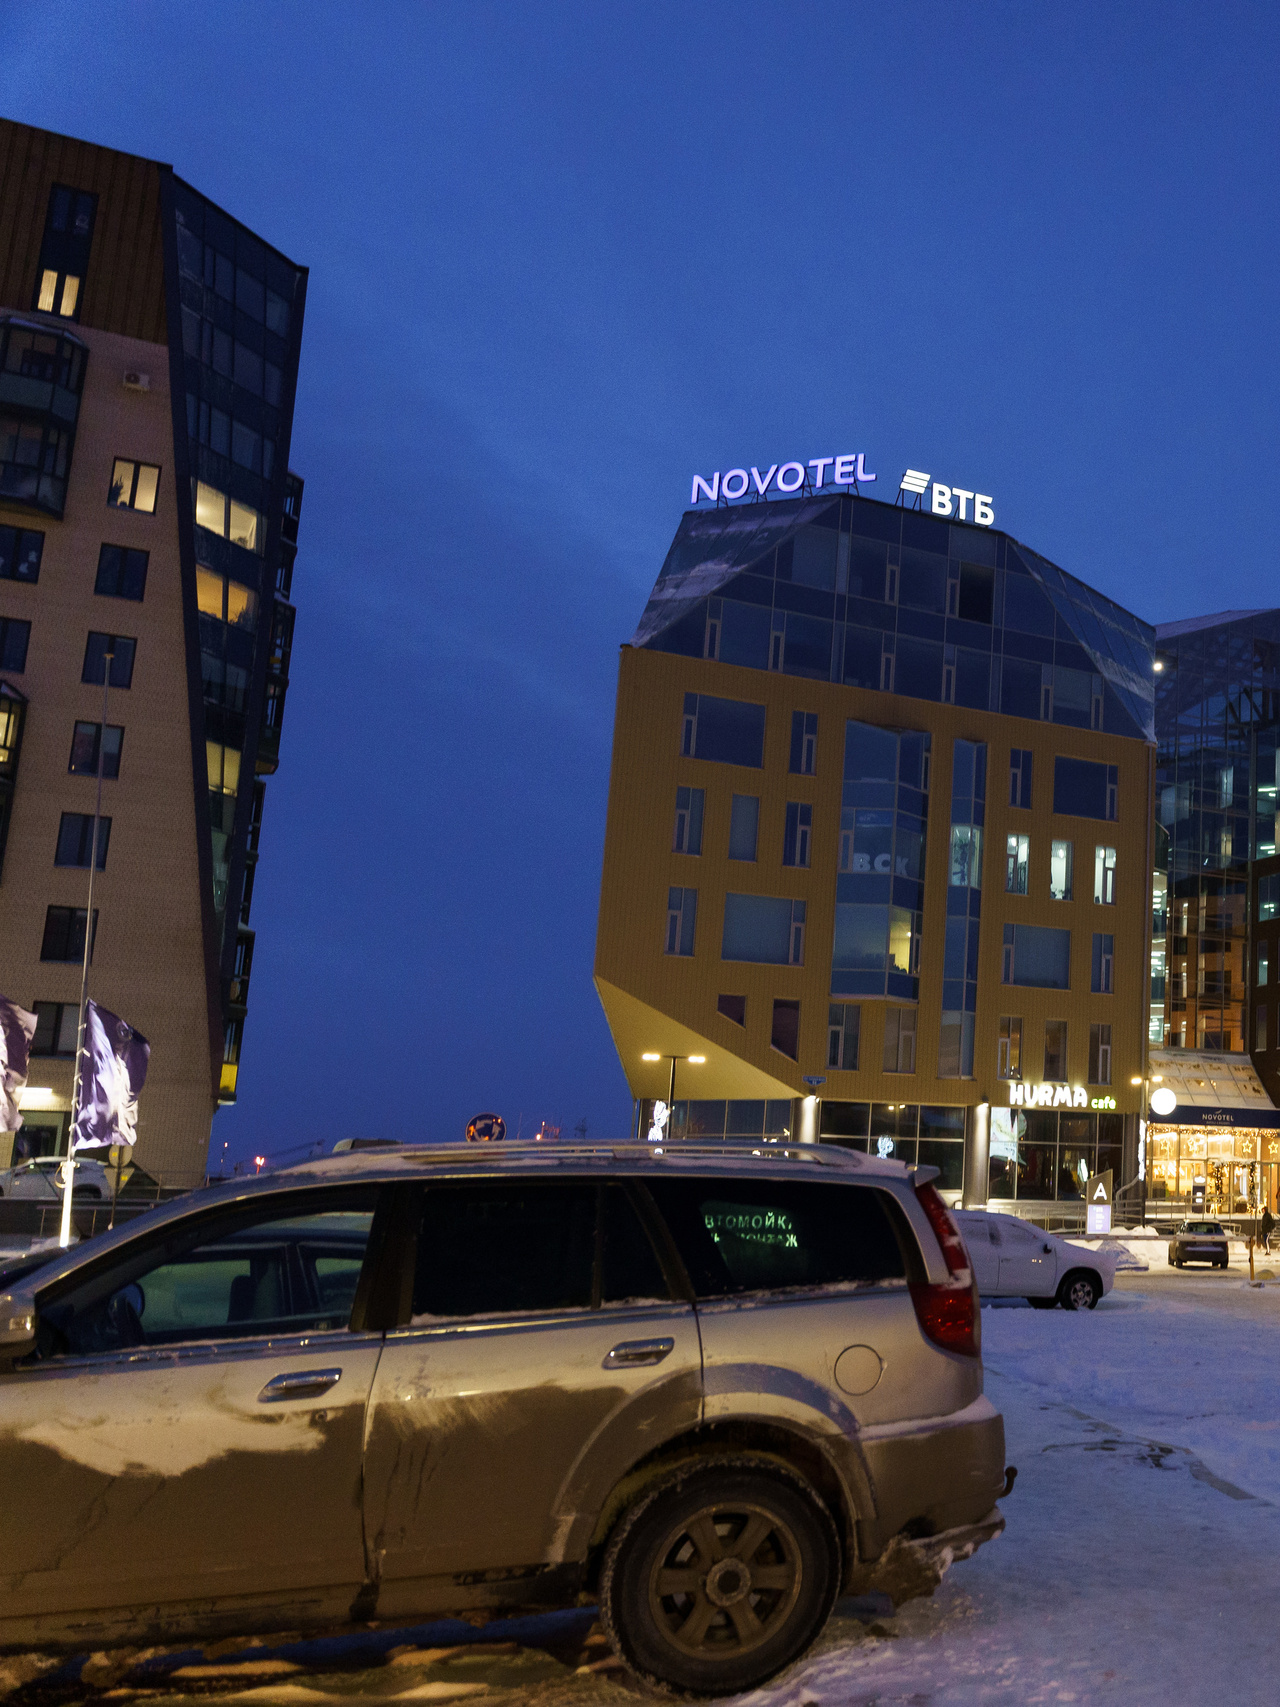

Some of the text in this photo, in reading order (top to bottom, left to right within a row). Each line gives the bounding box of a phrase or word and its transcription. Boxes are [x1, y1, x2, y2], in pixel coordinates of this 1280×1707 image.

[691, 453, 877, 504] NOVOTEL
[931, 483, 995, 526] ВТБ
[1009, 1083, 1088, 1108] HURMA
[1202, 1113, 1235, 1122] NOVOTEL
